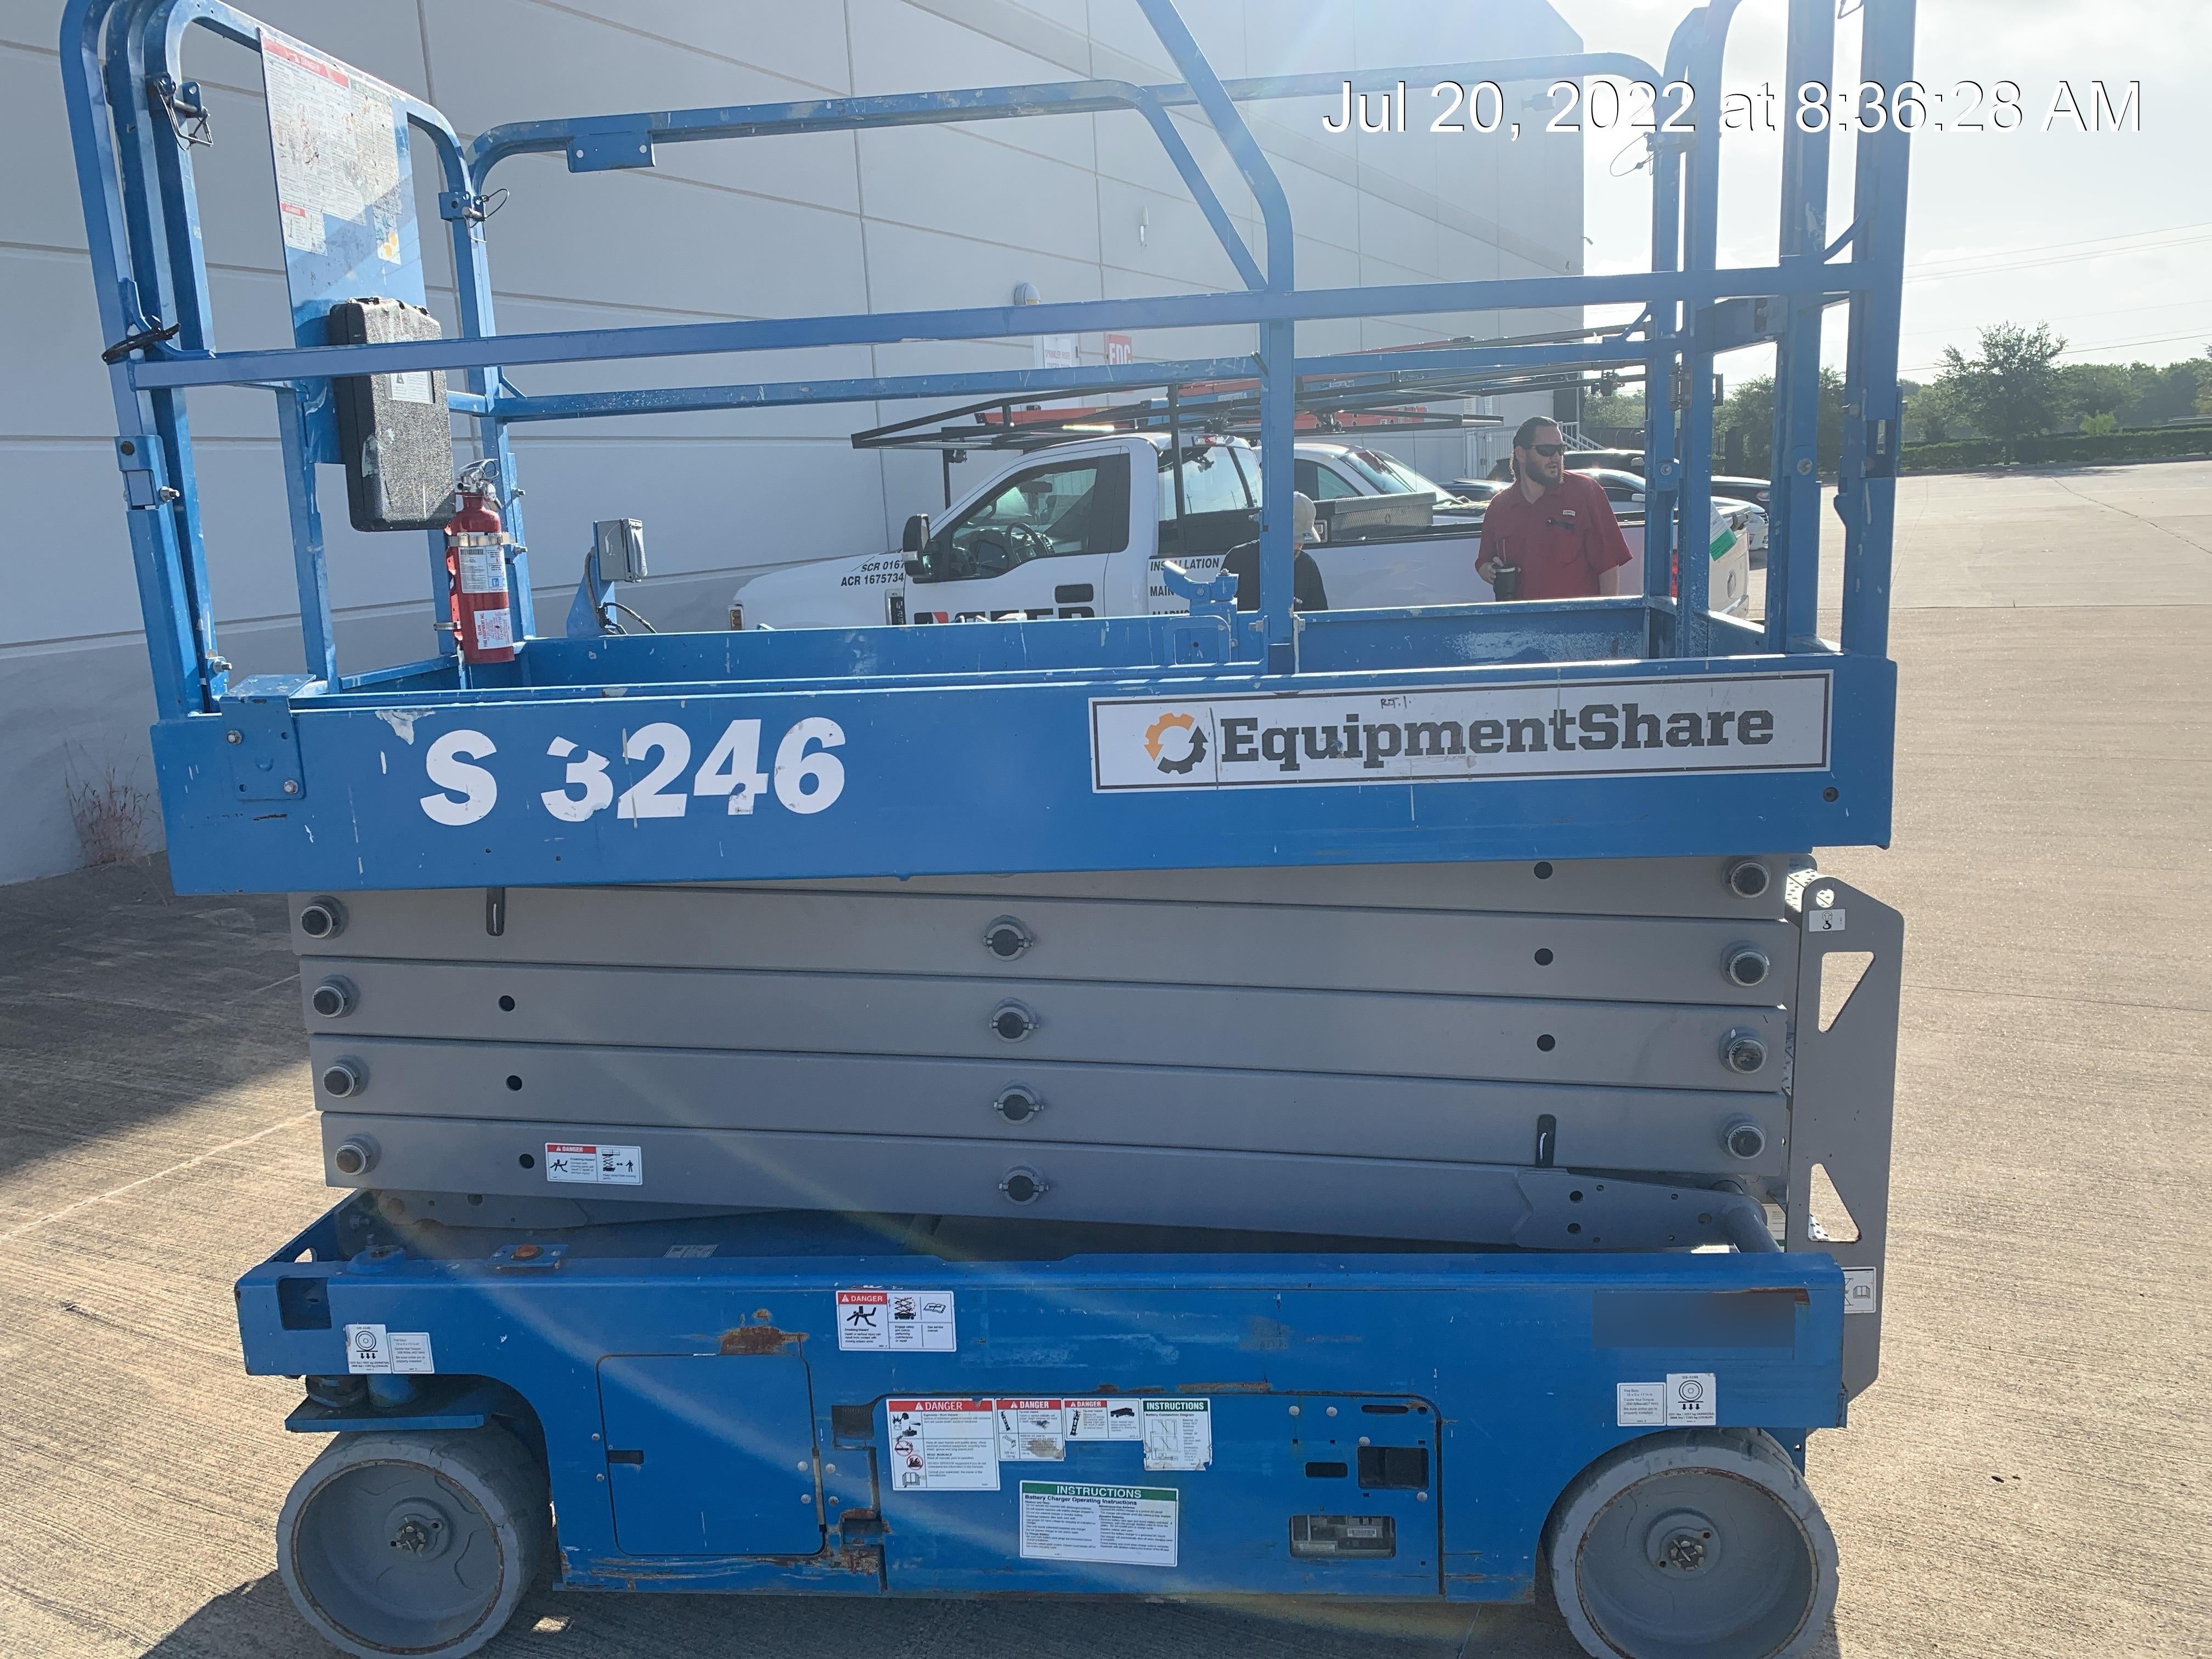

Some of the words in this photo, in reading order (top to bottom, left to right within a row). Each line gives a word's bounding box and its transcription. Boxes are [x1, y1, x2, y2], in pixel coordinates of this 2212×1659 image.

[861, 562, 881, 572] SCR
[841, 575, 861, 586] ACR
[864, 572, 904, 585] 1675734
[1221, 703, 1774, 771] EquipmentShare
[420, 730, 497, 826] S
[540, 717, 845, 822] 3246
[925, 1401, 963, 1411] DANGER
[1019, 1401, 1049, 1409] DANGER
[1146, 1402, 1204, 1410] INSTRUCTIONS
[1057, 1485, 1142, 1498] INSTRUCTIONS
